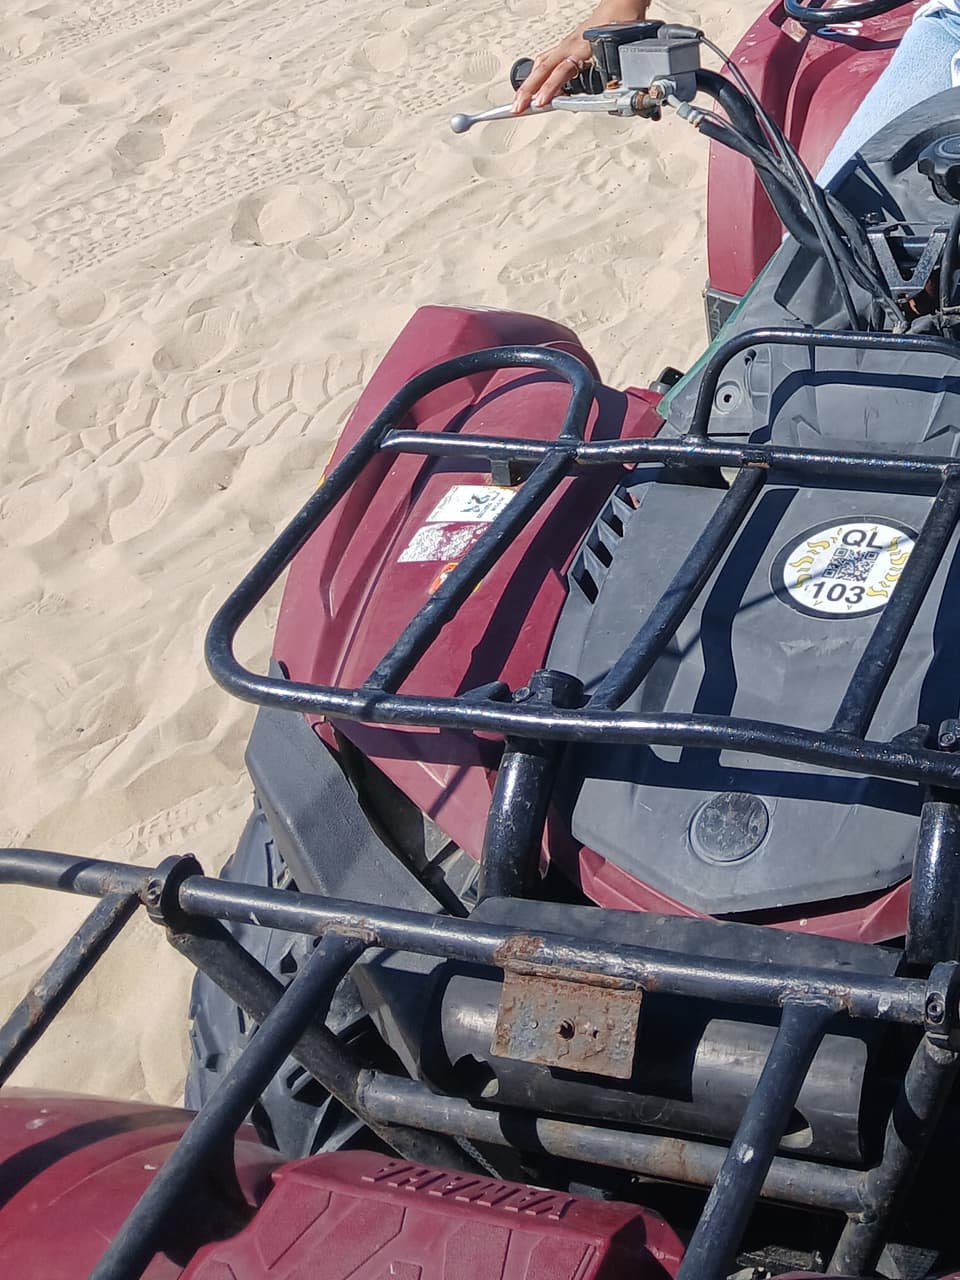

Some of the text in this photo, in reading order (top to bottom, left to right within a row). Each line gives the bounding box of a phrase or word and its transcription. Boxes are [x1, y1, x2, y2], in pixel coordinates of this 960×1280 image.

[842, 529, 884, 550] QL
[812, 581, 866, 604] 103
[361, 1161, 578, 1221] YAMAHA
